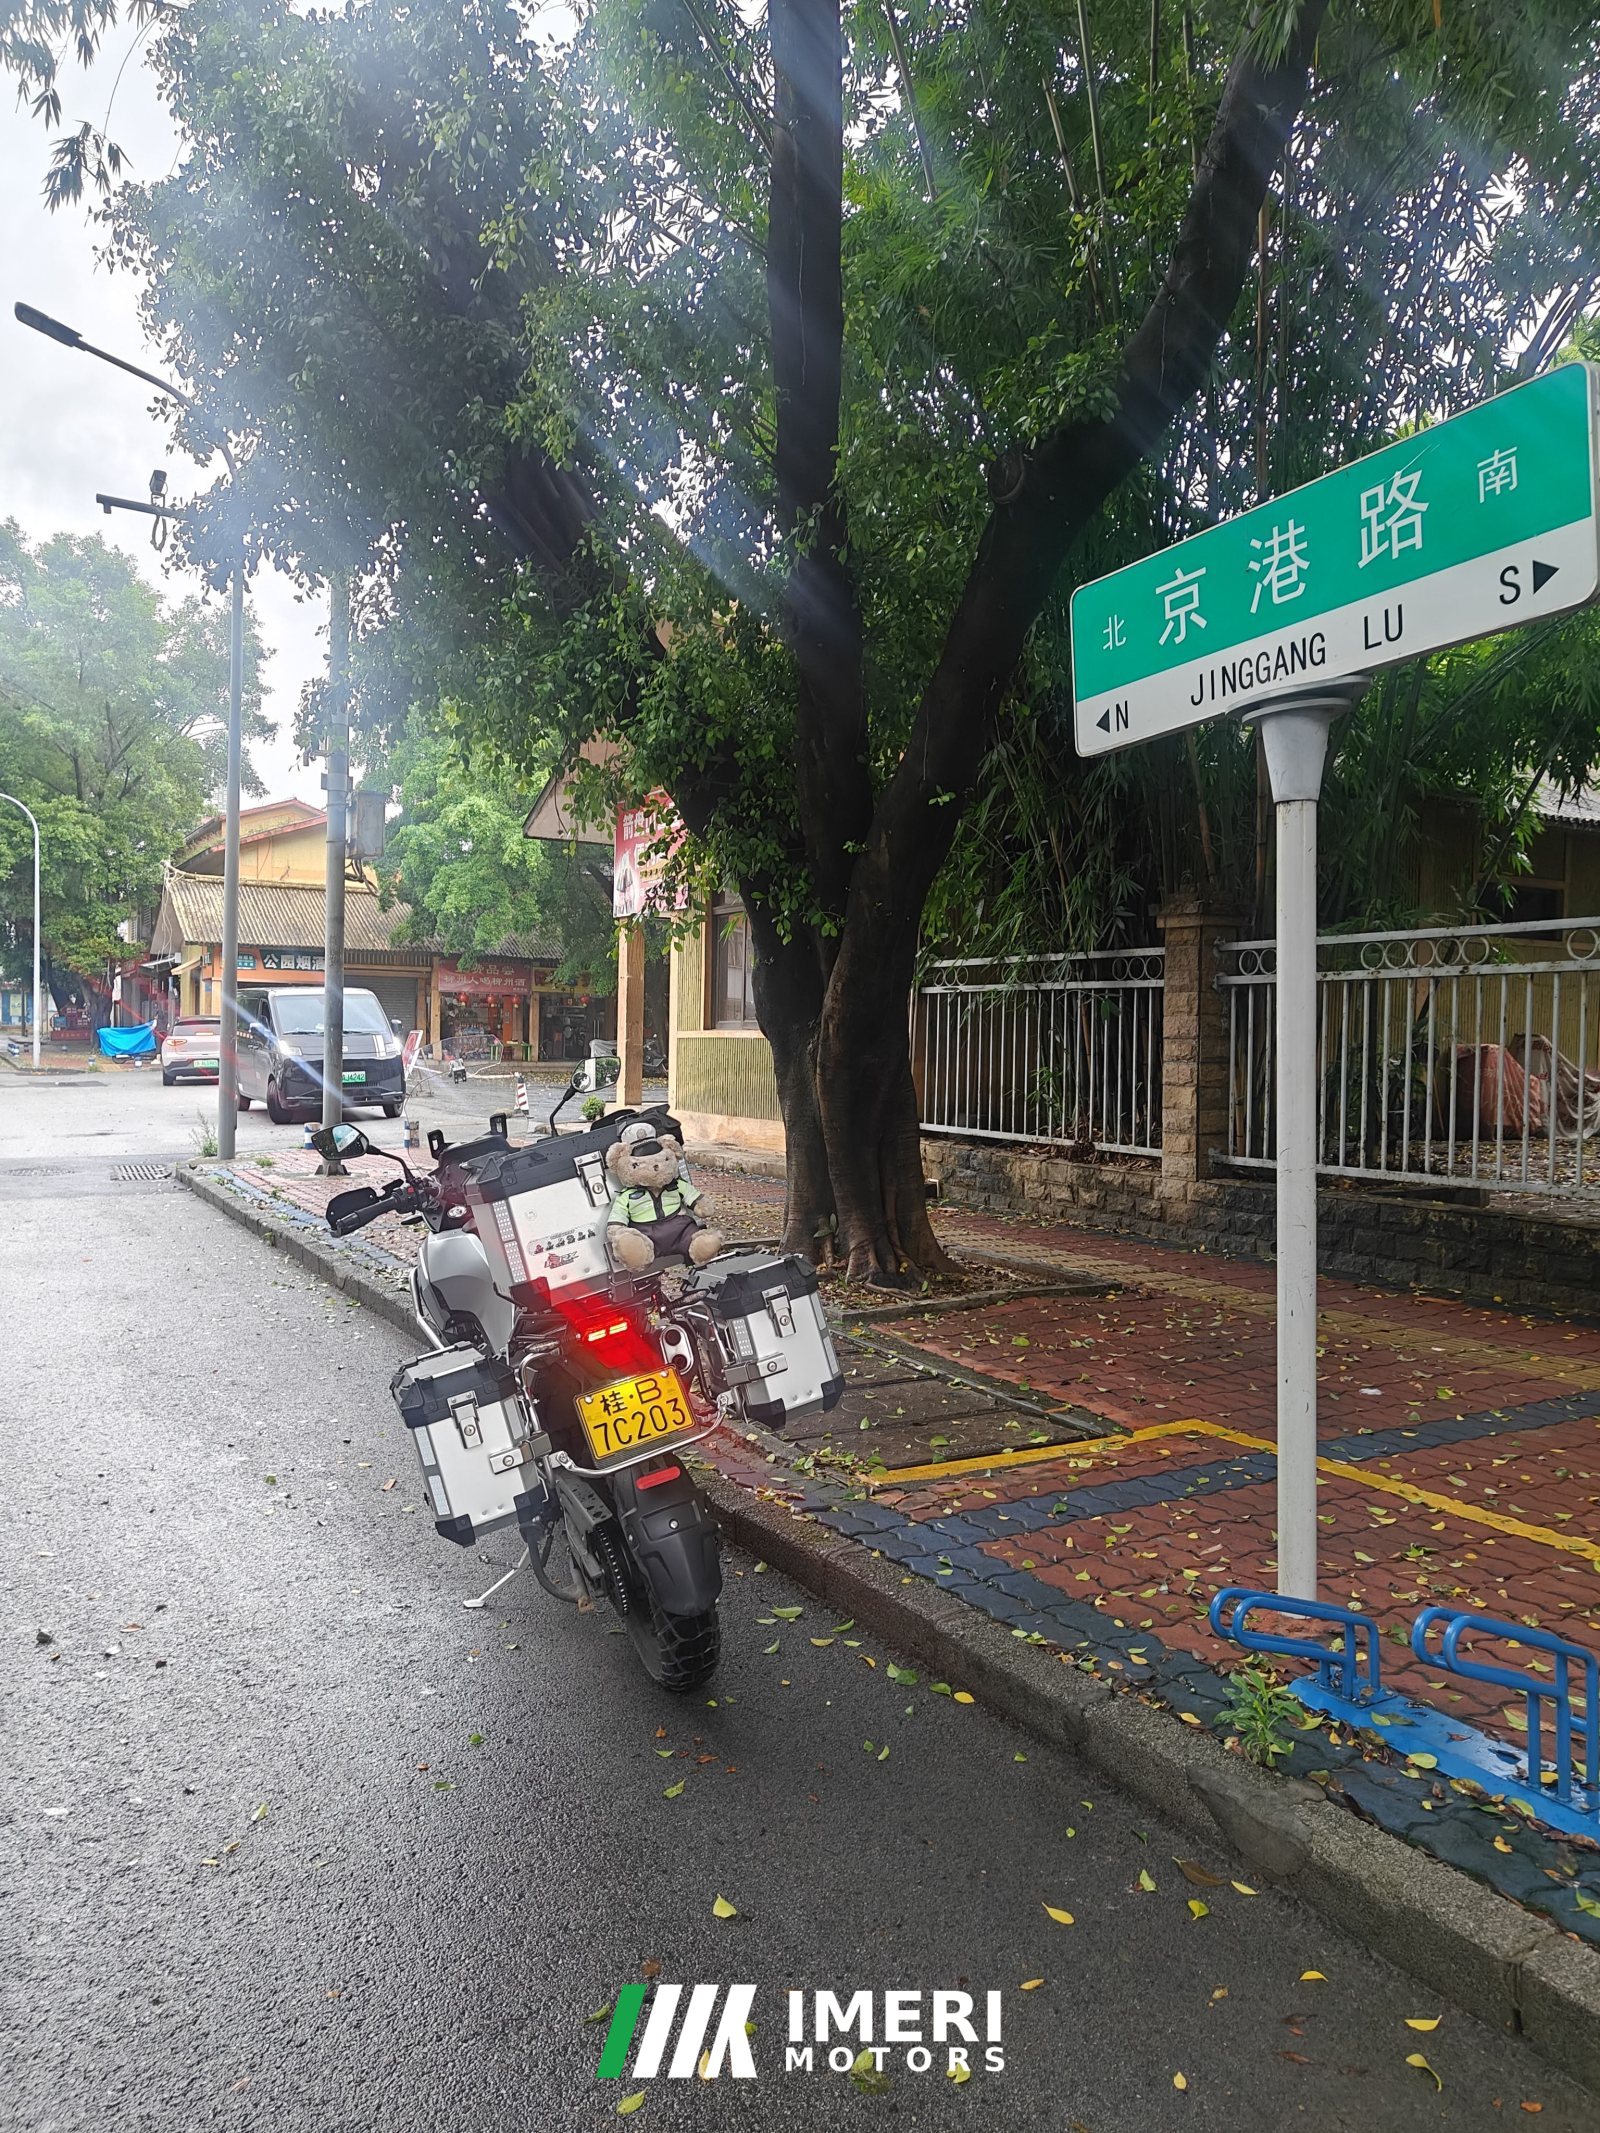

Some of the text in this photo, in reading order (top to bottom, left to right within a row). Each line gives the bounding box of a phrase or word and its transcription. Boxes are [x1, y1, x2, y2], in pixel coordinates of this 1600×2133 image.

[1102, 446, 1518, 650] 北 京港路 南
[1115, 566, 1521, 730] N JINGGANG LU S
[593, 1397, 686, 1451] 7C203
